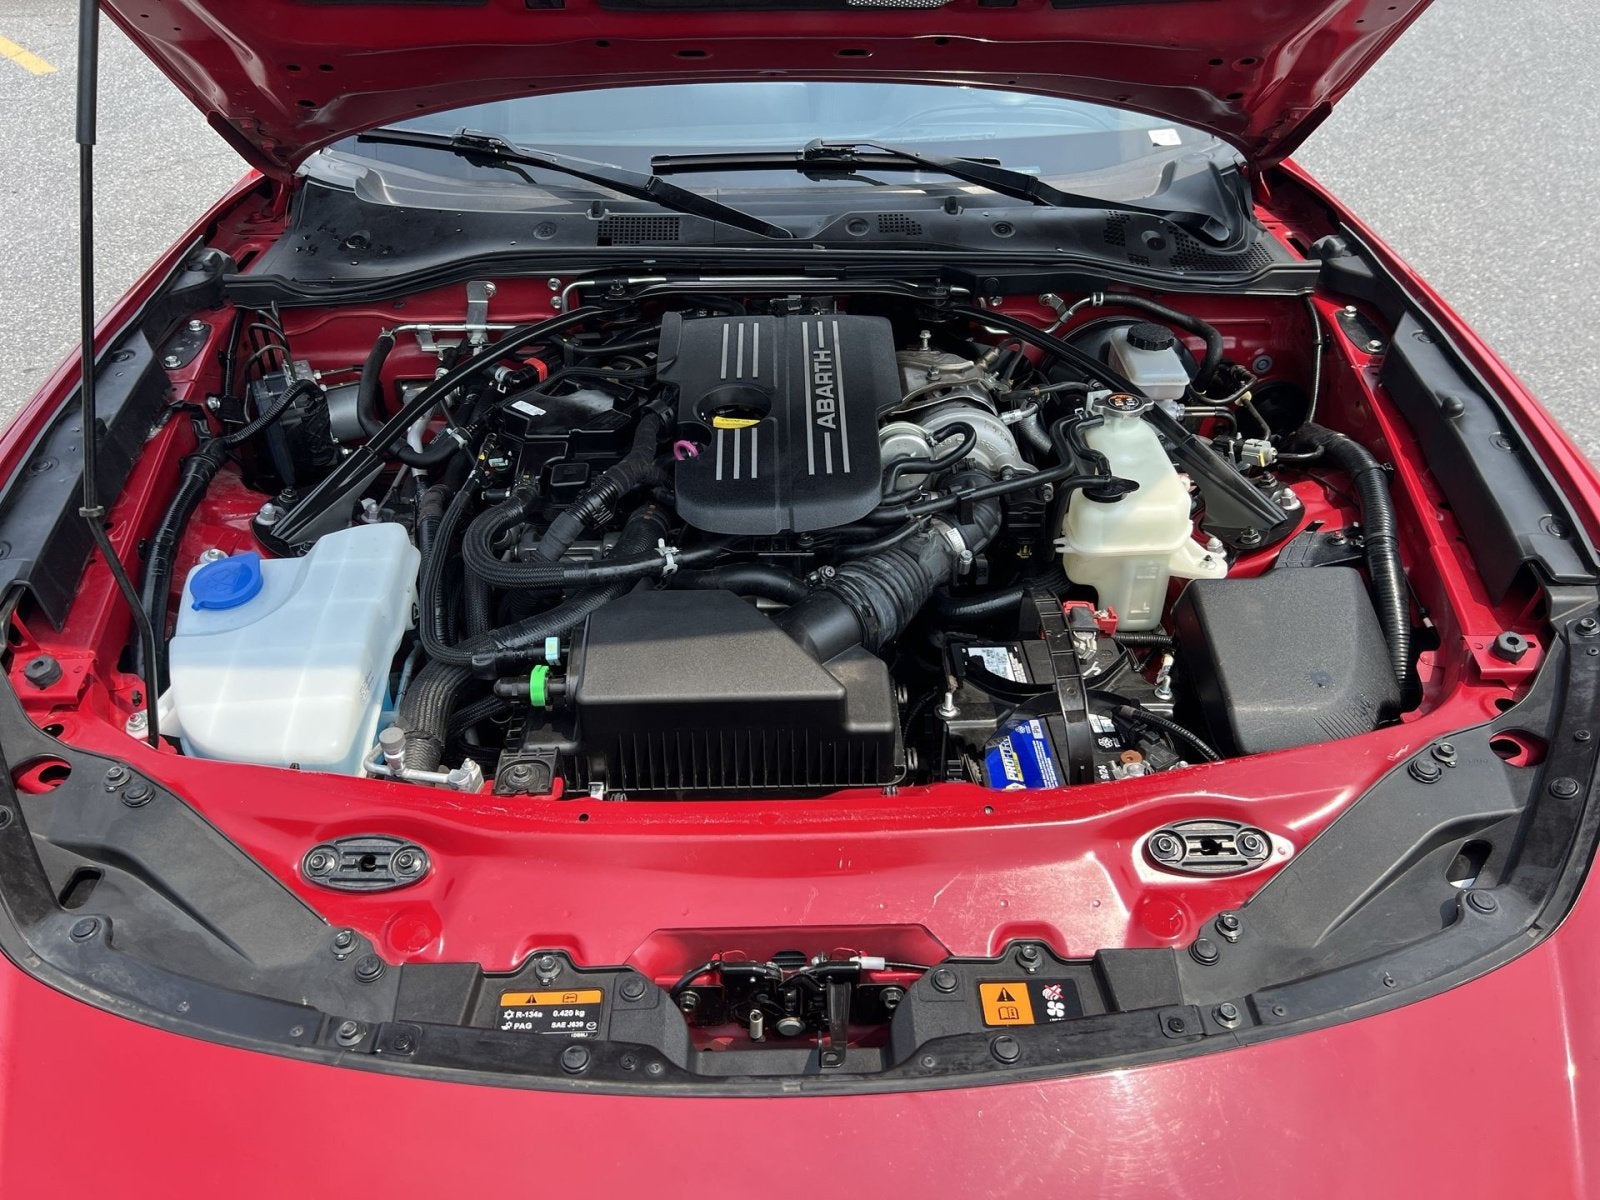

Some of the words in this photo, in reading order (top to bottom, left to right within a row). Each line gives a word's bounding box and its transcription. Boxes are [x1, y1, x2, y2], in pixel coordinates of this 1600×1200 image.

[813, 350, 836, 429] ABARTH
[1034, 725, 1040, 734] Pb
[515, 1010, 543, 1018] R-134a
[552, 1009, 574, 1018] 0.420
[574, 1009, 586, 1018] kg
[513, 1022, 533, 1030] PAG
[551, 1021, 566, 1029] SAE
